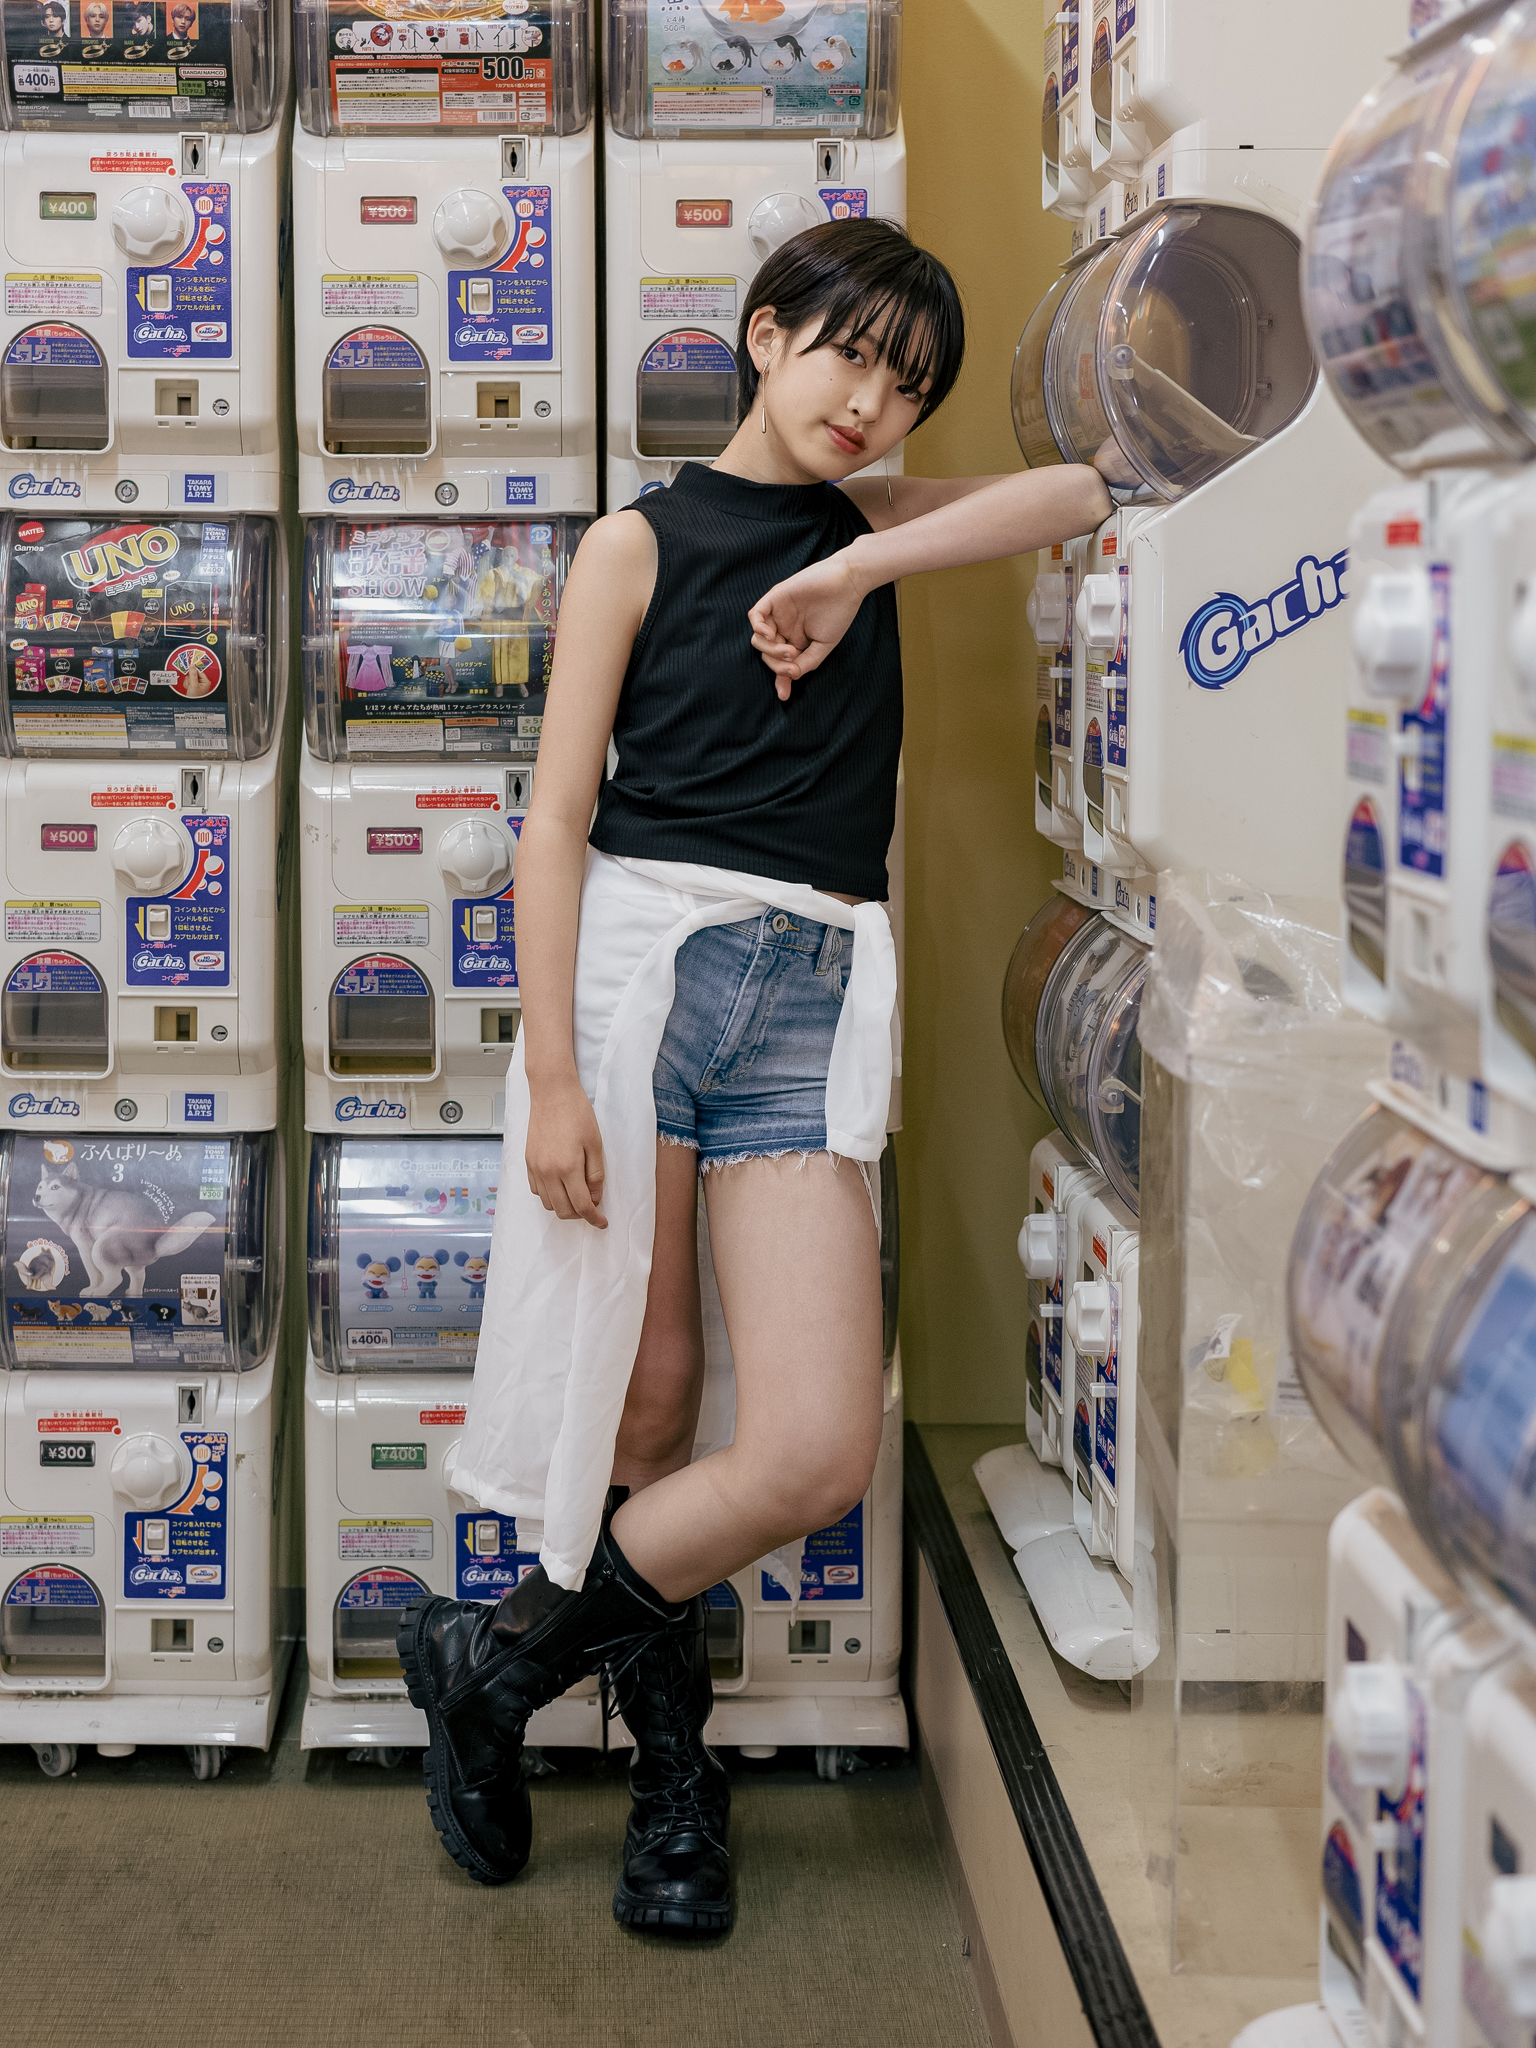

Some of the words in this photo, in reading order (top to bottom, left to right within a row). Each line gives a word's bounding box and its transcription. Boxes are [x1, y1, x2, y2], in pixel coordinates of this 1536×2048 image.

[482, 56, 535, 81] 500円
[49, 201, 88, 215] ¥400
[198, 200, 211, 211] 100
[369, 205, 407, 218] ¥500
[519, 202, 532, 213] 100
[835, 205, 848, 217] 100
[684, 209, 722, 222] ¥500
[18, 527, 44, 537] MATTEL
[352, 530, 425, 543] ミニチュア
[14, 544, 44, 552] Games
[61, 527, 180, 589] UNO
[349, 542, 427, 577] 歌謡
[348, 577, 427, 598] SHOW
[16, 599, 39, 612] UNO
[170, 602, 196, 616] UNO
[50, 830, 88, 843] ¥500
[198, 831, 210, 843] 100
[376, 834, 413, 847] ¥500
[174, 933, 223, 941] カプセルが出ます。
[400, 1159, 450, 1173] Capsule
[451, 1158, 500, 1172] Flockies
[112, 1163, 124, 1182] 3
[352, 1334, 388, 1344] 各400円
[48, 1446, 86, 1459] ¥300
[196, 1448, 208, 1459] 100
[380, 1449, 418, 1461] ¥400
